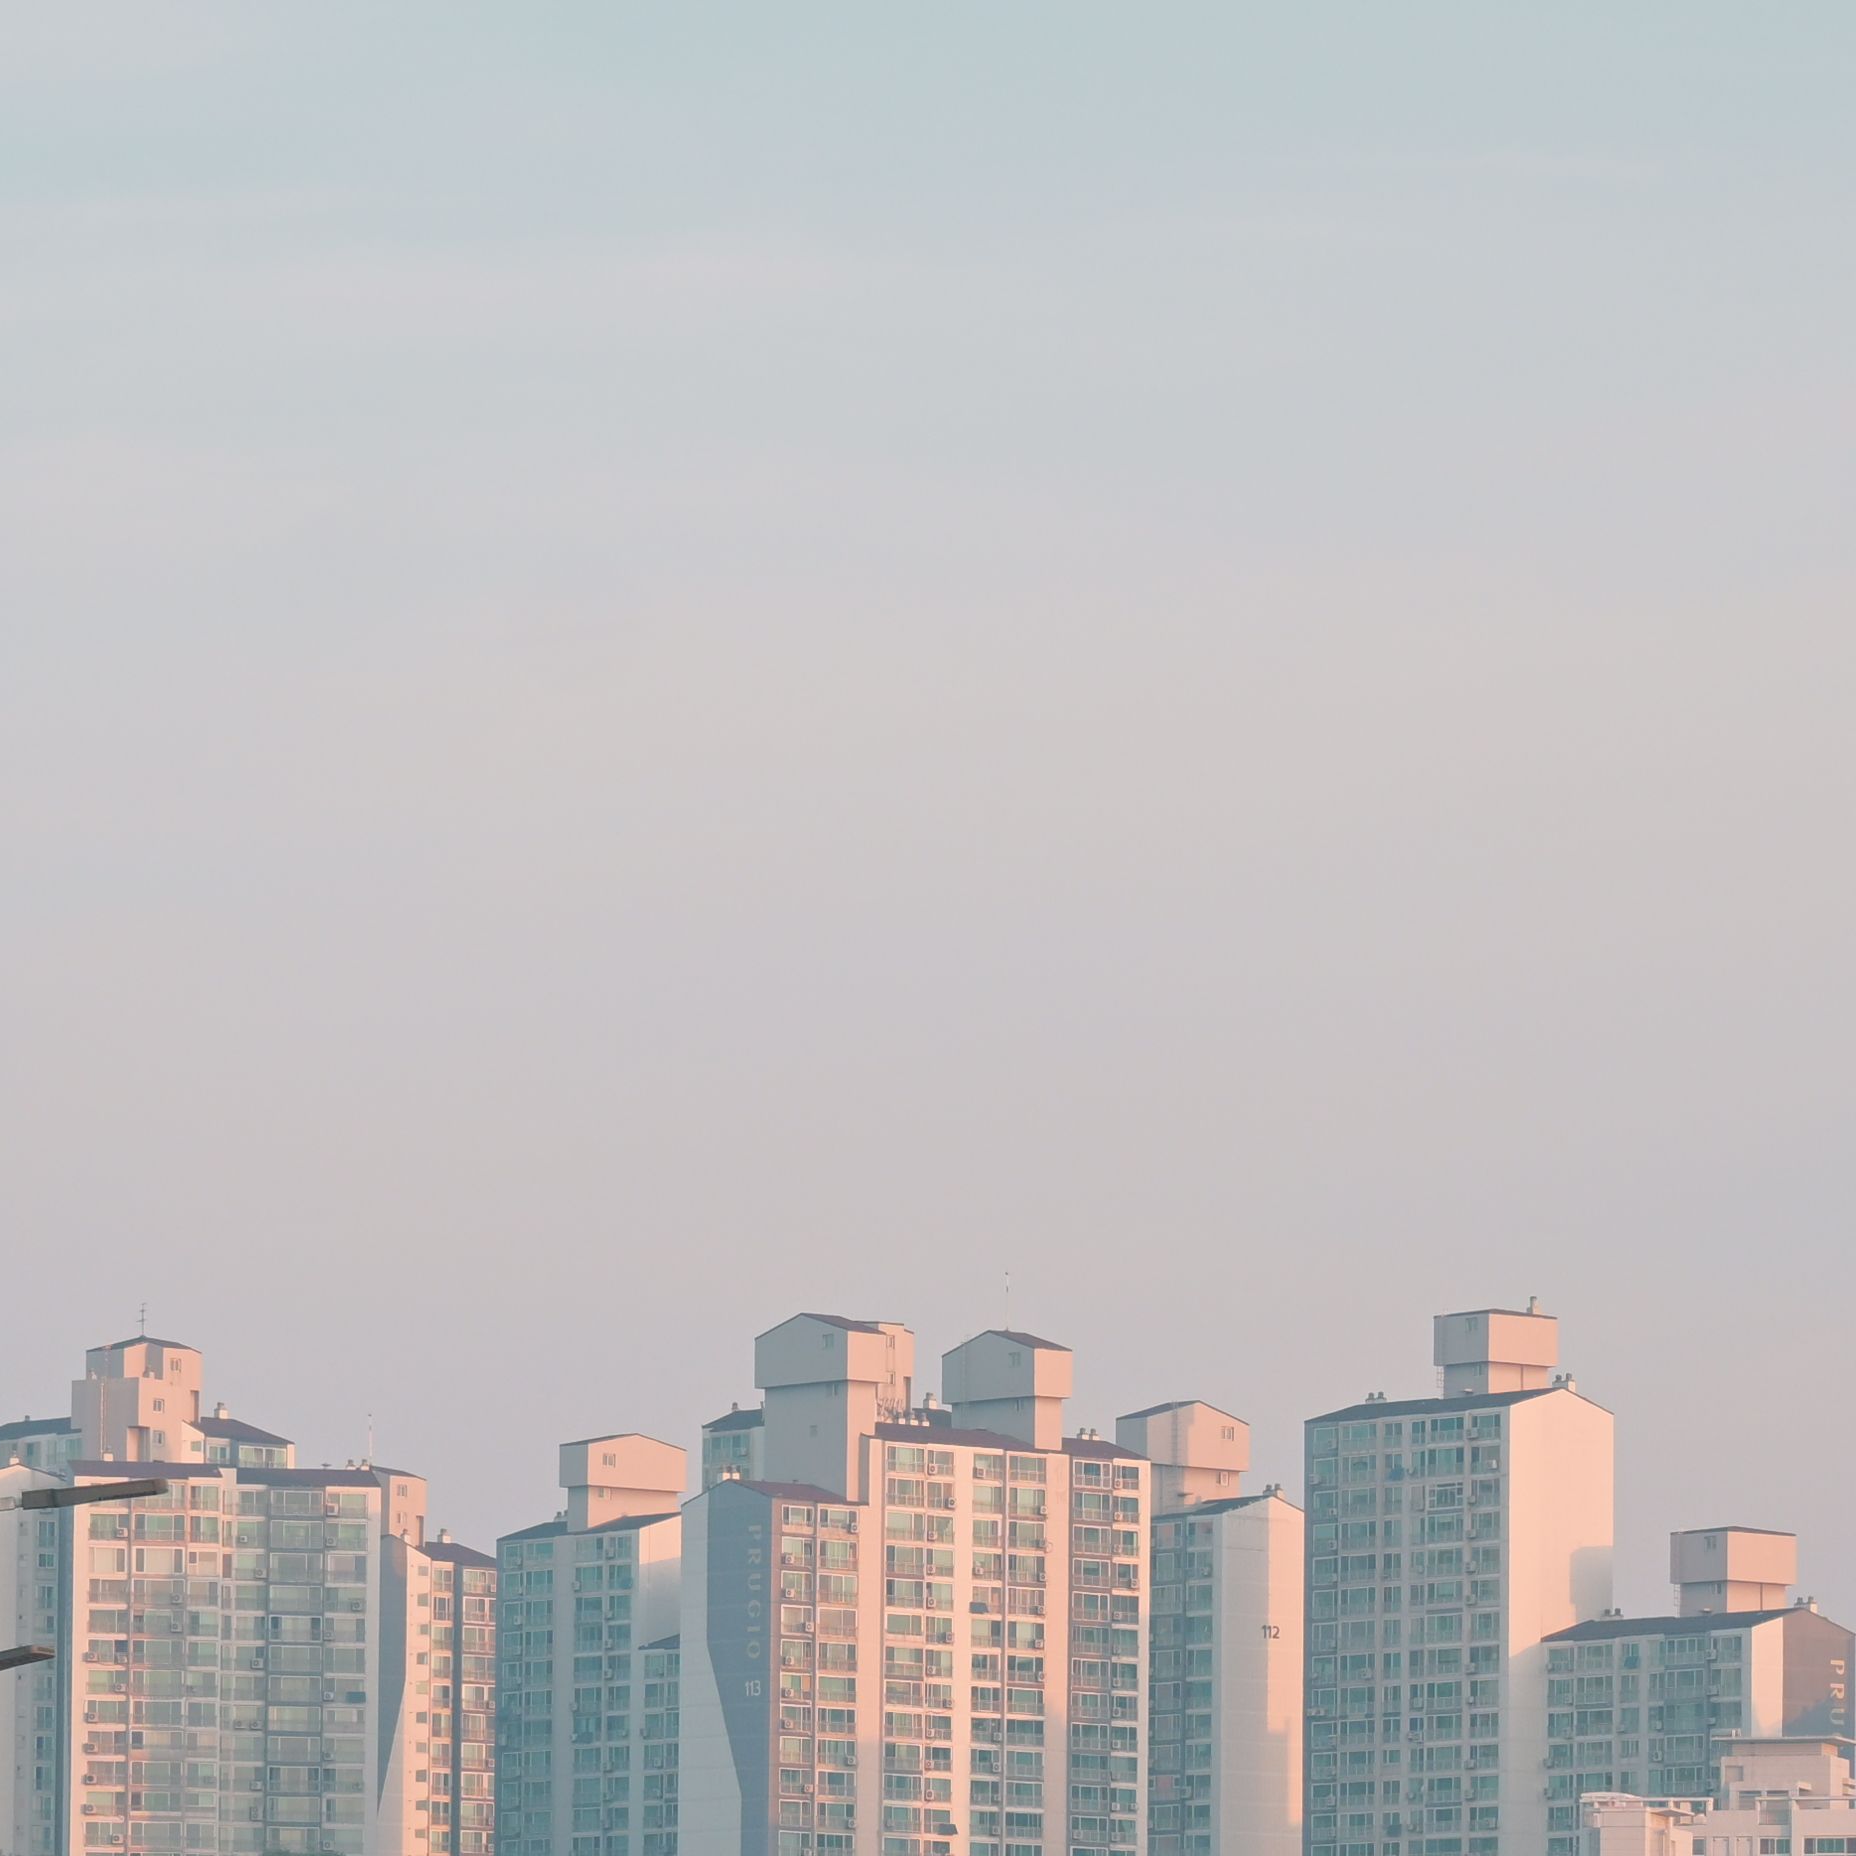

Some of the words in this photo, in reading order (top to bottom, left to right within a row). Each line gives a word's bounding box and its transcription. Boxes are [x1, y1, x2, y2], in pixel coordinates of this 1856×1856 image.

[747, 1524, 762, 1659] PRUGIO
[1261, 1625, 1280, 1639] 112
[745, 1680, 761, 1696] 113
[1830, 1659, 1845, 1737] PRU
